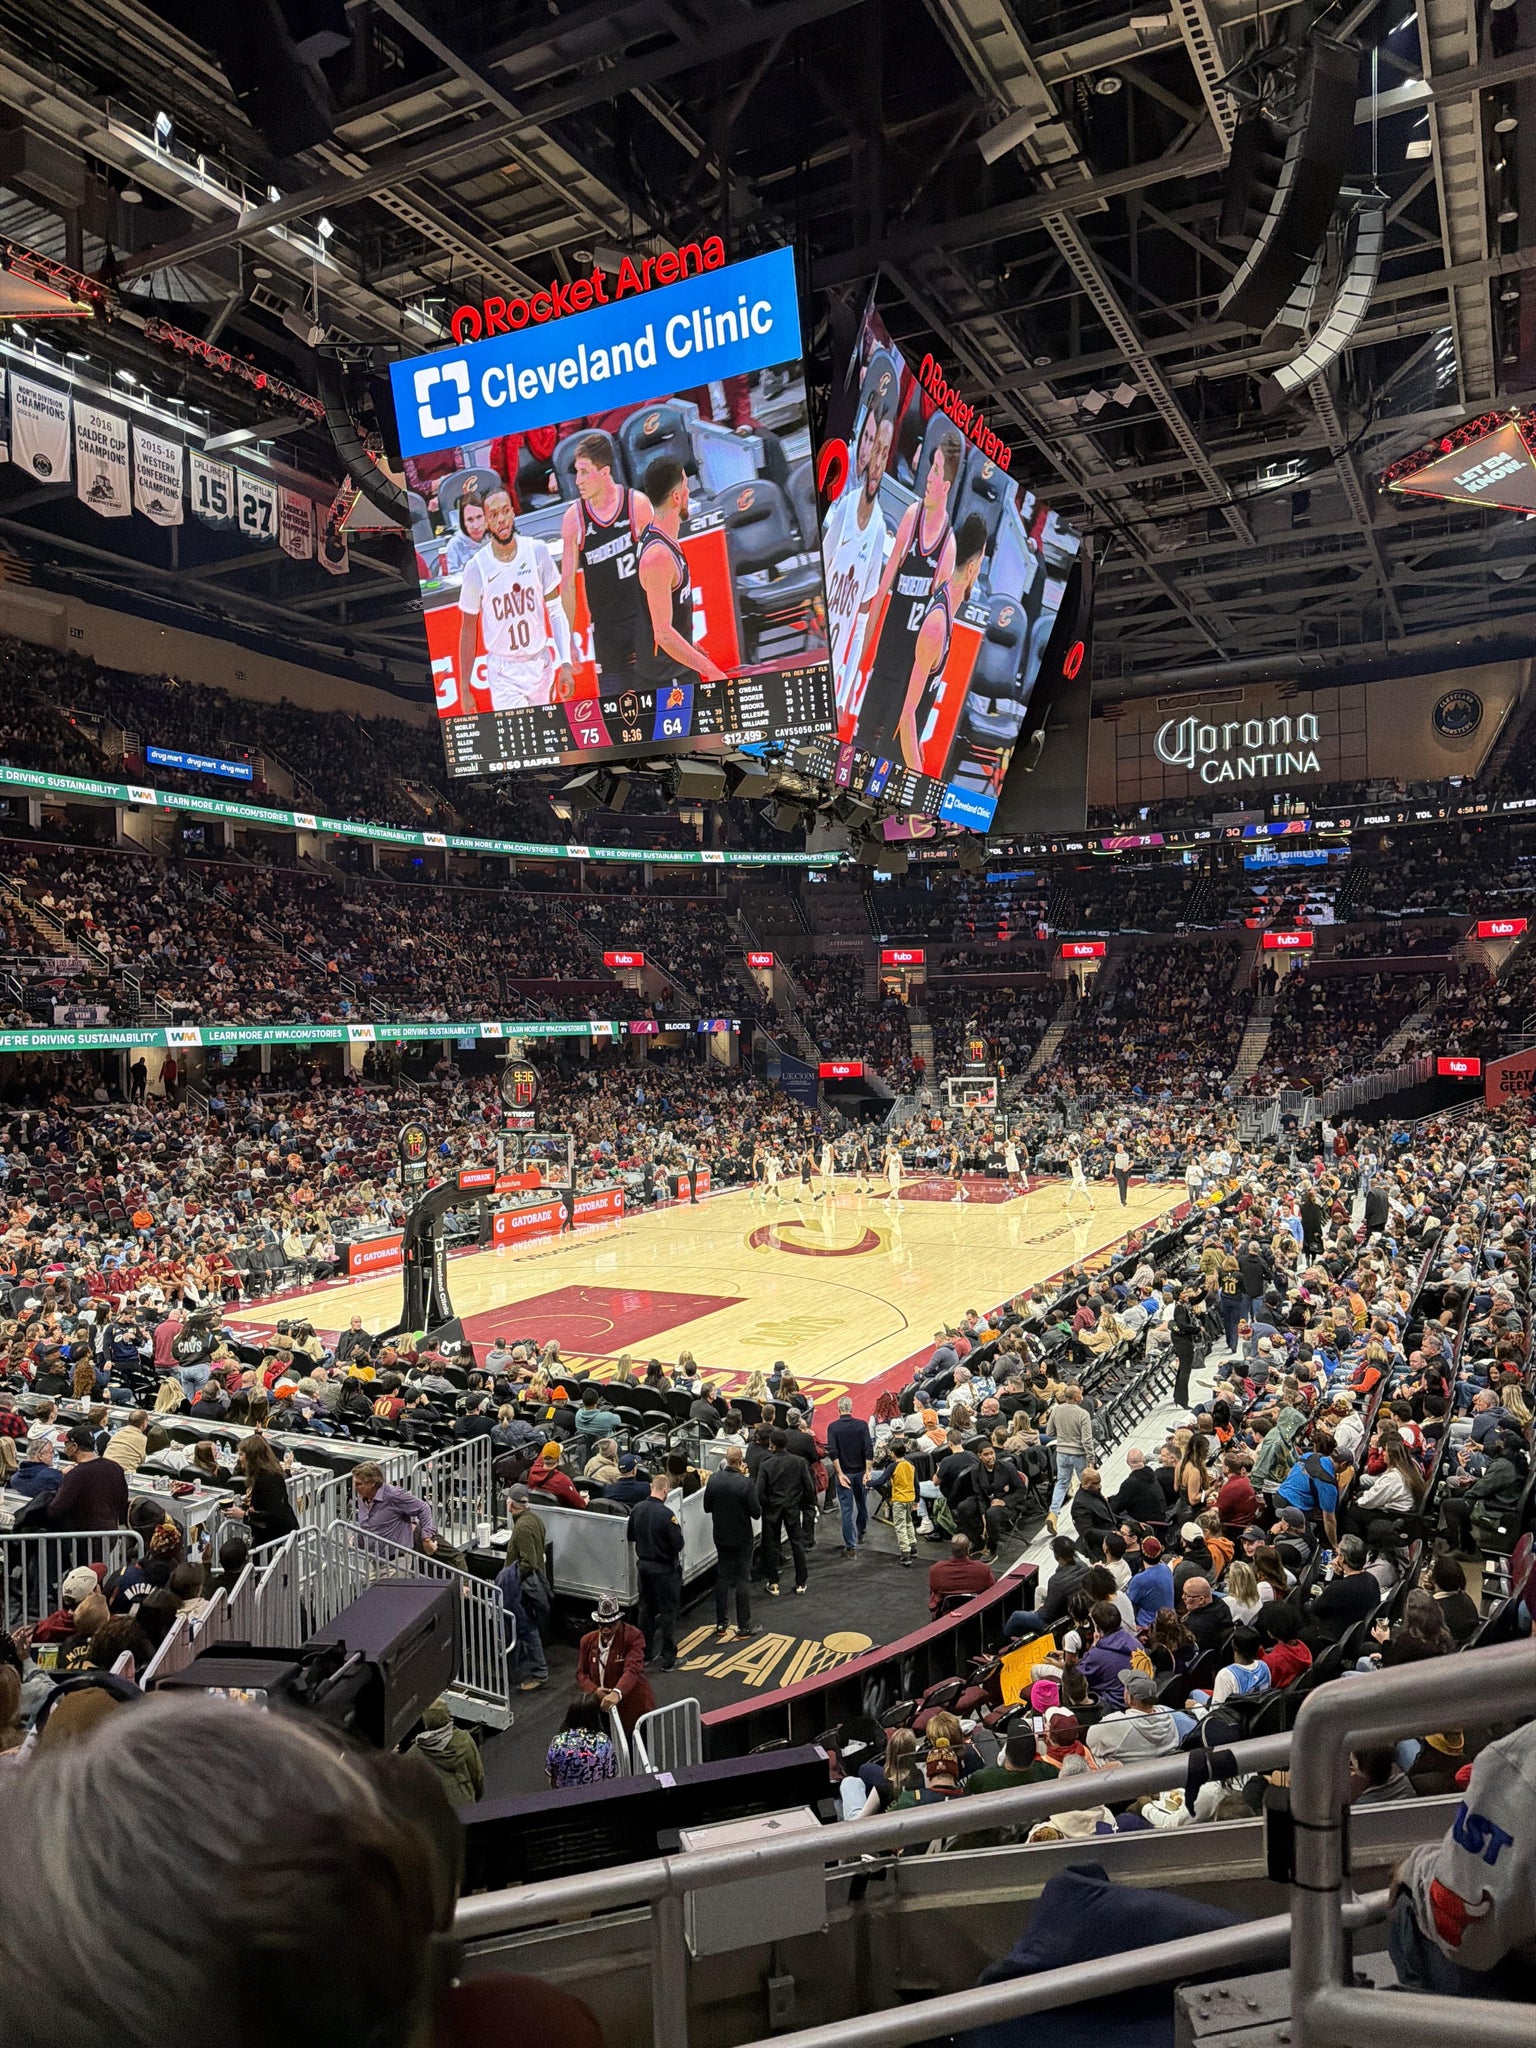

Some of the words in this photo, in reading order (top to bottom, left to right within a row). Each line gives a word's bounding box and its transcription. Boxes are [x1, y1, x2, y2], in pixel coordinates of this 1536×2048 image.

[487, 268, 609, 334] Rocket
[615, 235, 725, 298] Arena
[480, 324, 657, 408] Cleveland
[666, 295, 774, 358] Clinic
[18, 385, 37, 399] NORTH
[38, 391, 63, 409] DIVISION
[16, 394, 65, 420] CHAMPIONS
[90, 415, 112, 432] 2016
[929, 362, 975, 435] Rocket
[970, 414, 1011, 471] Arena
[77, 425, 107, 446] CALDER
[110, 438, 126, 452] CUP
[79, 440, 126, 465] CHAMPIONS
[140, 438, 176, 461] 2015-16
[142, 454, 175, 474] WESTERN
[1453, 464, 1486, 485] LET
[1482, 452, 1513, 471] EM
[137, 464, 181, 489] CONFERENCE
[1464, 459, 1528, 493] KNOW.
[139, 477, 179, 500] CHAMPIONS
[199, 475, 227, 514] 15
[243, 493, 273, 532] 27
[690, 510, 725, 531] anc
[616, 553, 636, 580] 12
[492, 586, 535, 621] CAVS
[906, 602, 925, 631] 12
[508, 620, 531, 651] 10
[641, 695, 652, 709] 14
[740, 694, 764, 702] BOOKER
[604, 702, 617, 713] 3Q
[740, 702, 765, 711] BROOKS
[663, 718, 682, 735] 64
[775, 722, 832, 738] CAVS5050.COM
[581, 728, 600, 745] 75
[622, 728, 642, 743] 9:36
[723, 730, 761, 745] $12,499
[1154, 711, 1322, 769] Corona
[151, 750, 167, 762] drug
[167, 755, 182, 763] mart
[187, 757, 202, 768] drug
[202, 762, 217, 770] mart
[523, 756, 560, 768] RAFFLE
[220, 763, 234, 774] drug
[235, 767, 249, 775] mart
[455, 762, 479, 774] oswald
[838, 767, 848, 782] 75
[1200, 750, 1322, 784] CANTINA
[6, 770, 45, 785] DRIVING
[47, 777, 117, 795] SUSTAINABILITY
[871, 780, 880, 793] 64
[132, 790, 153, 800] WM
[163, 794, 189, 807] LEARN
[191, 798, 213, 810] MORE
[214, 802, 224, 812] AT
[225, 802, 288, 822] WM.COM/STORIES
[954, 799, 978, 814] Cleveland
[977, 807, 991, 819] Clinic
[297, 816, 314, 826] WM
[1315, 821, 1335, 829] FG%
[1339, 819, 1351, 828] 39
[1364, 815, 1390, 825] FOULS
[1397, 813, 1404, 822] 2
[1416, 811, 1432, 820] TOL
[1438, 810, 1445, 818] 5
[1475, 805, 1488, 813] PM
[322, 820, 342, 831] WE'RE
[343, 823, 367, 835] DRIVING
[368, 827, 416, 842] SUSTAINABILITY
[426, 835, 443, 844] WM
[452, 838, 473, 848] LEARN
[475, 841, 493, 849] MORE
[494, 842, 502, 850] AT
[502, 843, 559, 854] WM.COM/STORIES
[1008, 847, 1014, 855] 3
[1139, 836, 1151, 845] 75
[1170, 834, 1179, 842] 14
[1226, 829, 1241, 837] 3Q
[1255, 826, 1268, 835] 64
[570, 848, 588, 856] WM
[595, 850, 615, 858] WE'RE
[617, 851, 642, 859] DRIVING
[643, 852, 694, 861] SUSTAINABILITY
[704, 853, 721, 861] WM
[1491, 922, 1513, 933] fubo
[1277, 935, 1299, 945] fubo
[893, 952, 912, 960] fubo
[1074, 945, 1093, 954] fubo
[615, 955, 633, 963] fubo
[752, 955, 769, 963] fubo
[352, 1028, 372, 1038] WM
[380, 1028, 402, 1037] WE'RE
[402, 1027, 428, 1036] DRIVING
[429, 1026, 474, 1036] SUSTAINABILITY
[483, 1026, 499, 1034] WM
[506, 1025, 523, 1033] LEARN
[524, 1025, 539, 1033] MORE
[647, 1023, 652, 1031] 4
[665, 1023, 691, 1031] BLOCKS
[703, 1022, 709, 1030] 2
[32, 1033, 75, 1045] DRIVING
[78, 1032, 154, 1044] SUSTAINABILITY
[171, 1032, 197, 1042] WM
[209, 1030, 238, 1041] LEARN
[239, 1030, 263, 1040] MORE
[263, 1030, 274, 1039] AT
[275, 1028, 342, 1040] WM.COM/STORIES
[971, 1048, 983, 1060] 14
[832, 1066, 850, 1074] fubo
[1450, 1061, 1467, 1071] fubo
[514, 1071, 534, 1082] 9:36
[1501, 1070, 1531, 1080] SEAT
[516, 1082, 532, 1103] 14
[408, 1132, 423, 1144] 9:36
[410, 1143, 421, 1156] 14
[463, 1173, 492, 1183] GATORADE
[613, 1193, 622, 1207] G
[496, 1218, 505, 1234] G
[512, 1211, 552, 1228] GATORADE
[354, 1254, 362, 1266] G
[363, 1247, 399, 1262] GATORADE
[436, 1252, 445, 1293] Cleveland
[1224, 1282, 1236, 1295] 10
[440, 1292, 450, 1316] Clinic
[178, 1336, 203, 1353] CAVS
[375, 1400, 393, 1416] 10
[124, 1583, 155, 1600] MITCH
[66, 1645, 90, 1662] MITC
